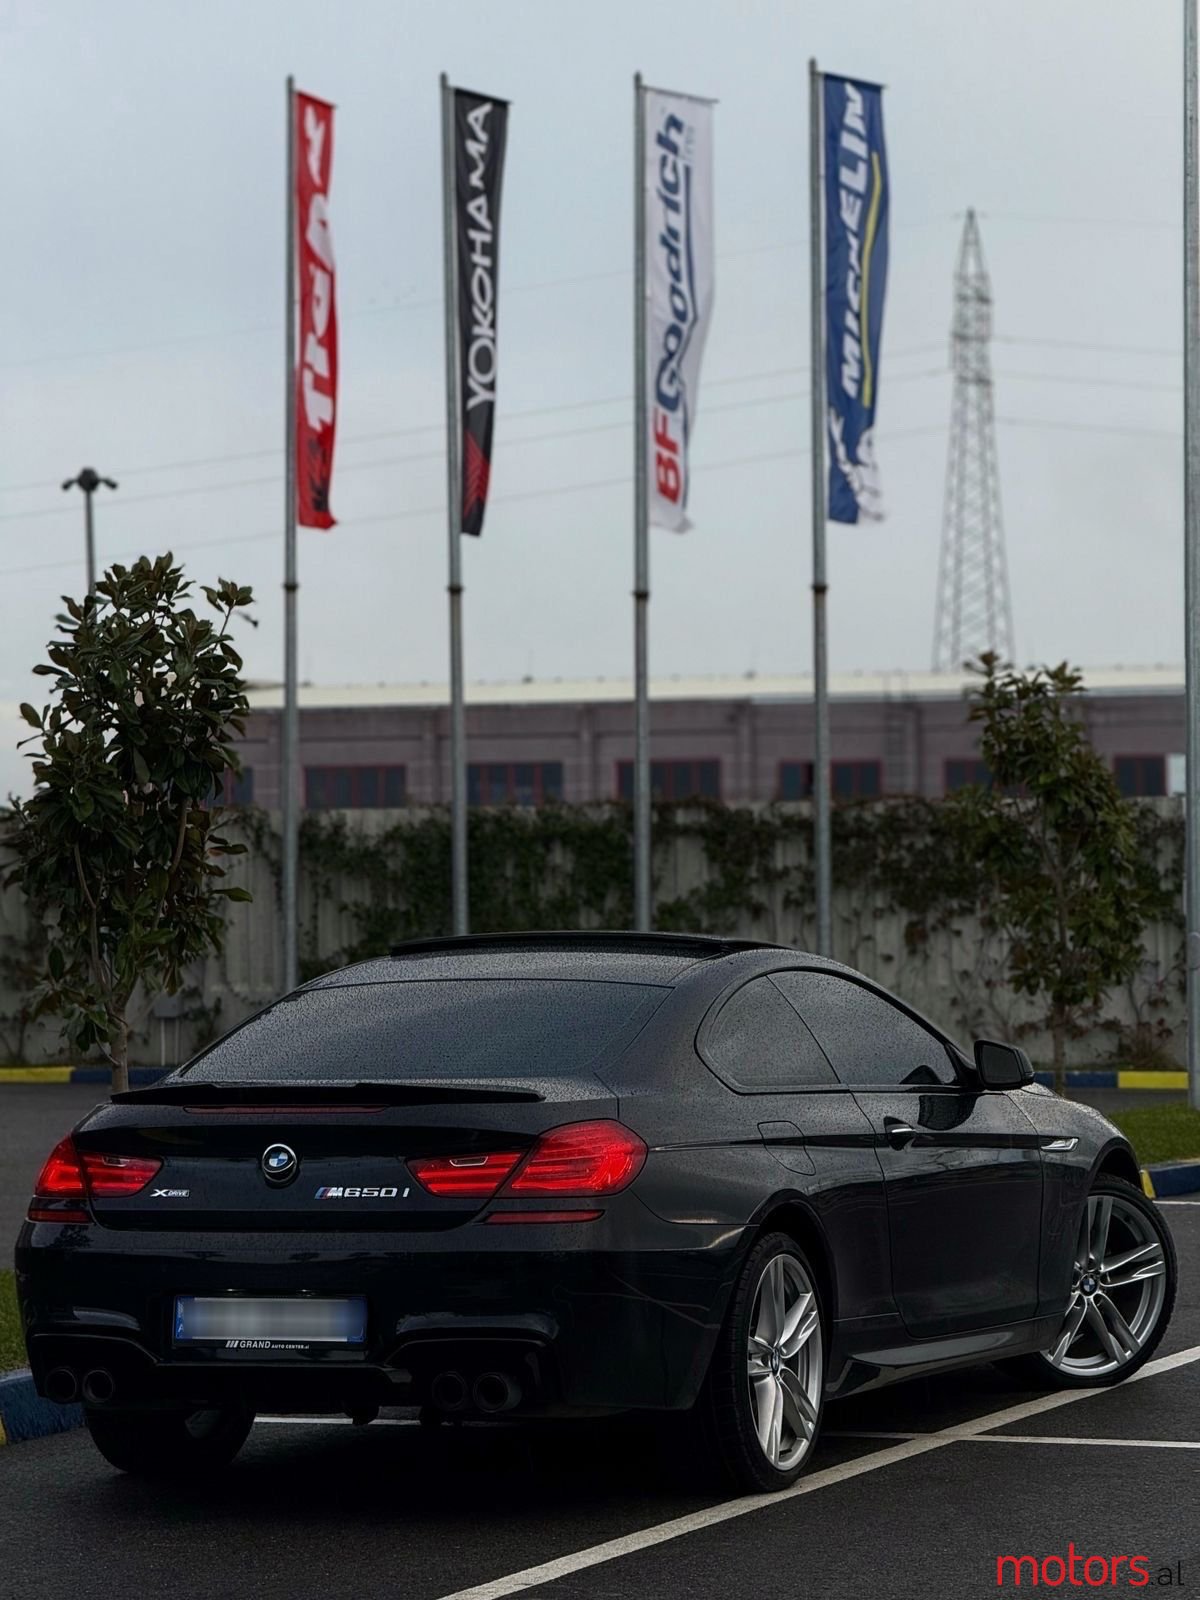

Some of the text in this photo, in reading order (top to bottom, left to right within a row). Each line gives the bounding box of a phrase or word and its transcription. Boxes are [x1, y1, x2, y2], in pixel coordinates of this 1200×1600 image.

[466, 102, 497, 410] YOKOHAMA
[653, 111, 688, 505] BFGoodrich
[838, 82, 868, 399] MICHELIN
[240, 1340, 271, 1349] GRAND
